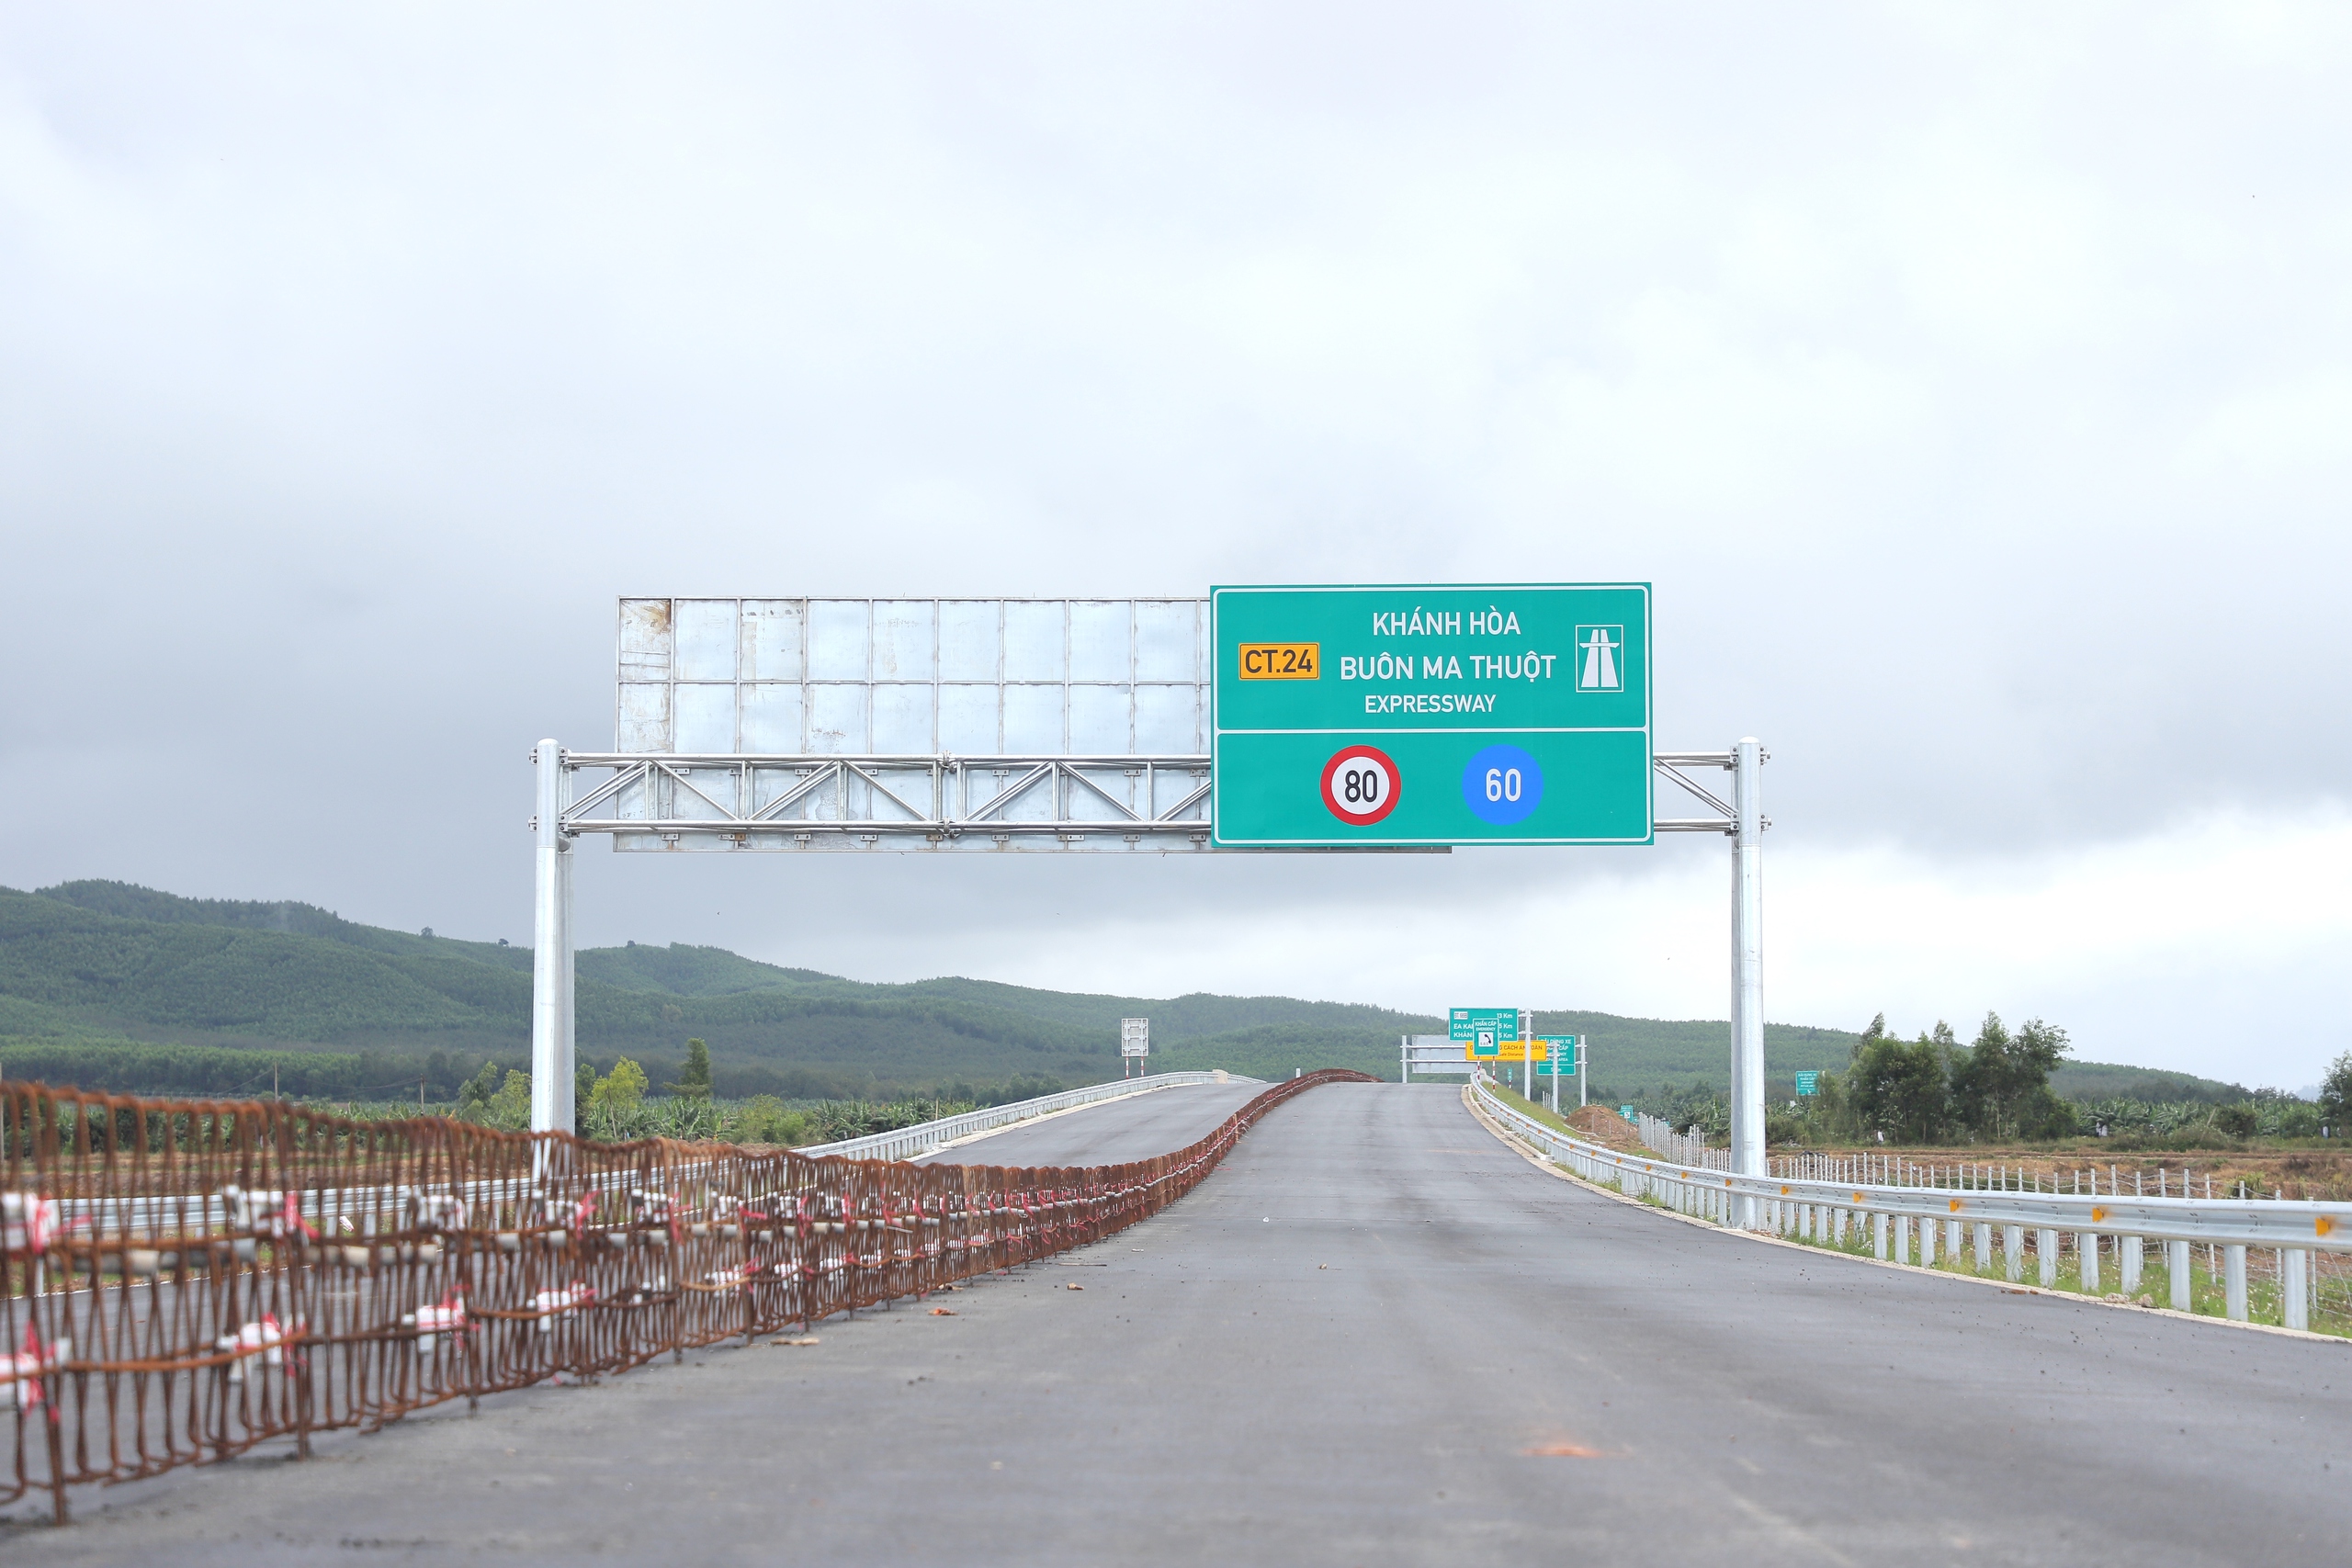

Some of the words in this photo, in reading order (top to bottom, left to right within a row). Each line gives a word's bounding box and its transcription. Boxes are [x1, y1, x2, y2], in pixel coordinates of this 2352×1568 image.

[1373, 606, 1461, 636] KHÁNH
[1469, 605, 1521, 636] HÒA
[1245, 649, 1313, 673] CT.24
[1340, 652, 1413, 680] BUÔN
[1422, 655, 1464, 680] MA
[1469, 650, 1556, 682] THUỘT
[1364, 694, 1496, 714] EXPRESSWAY
[1344, 770, 1378, 803] 80
[1486, 768, 1521, 802] 60
